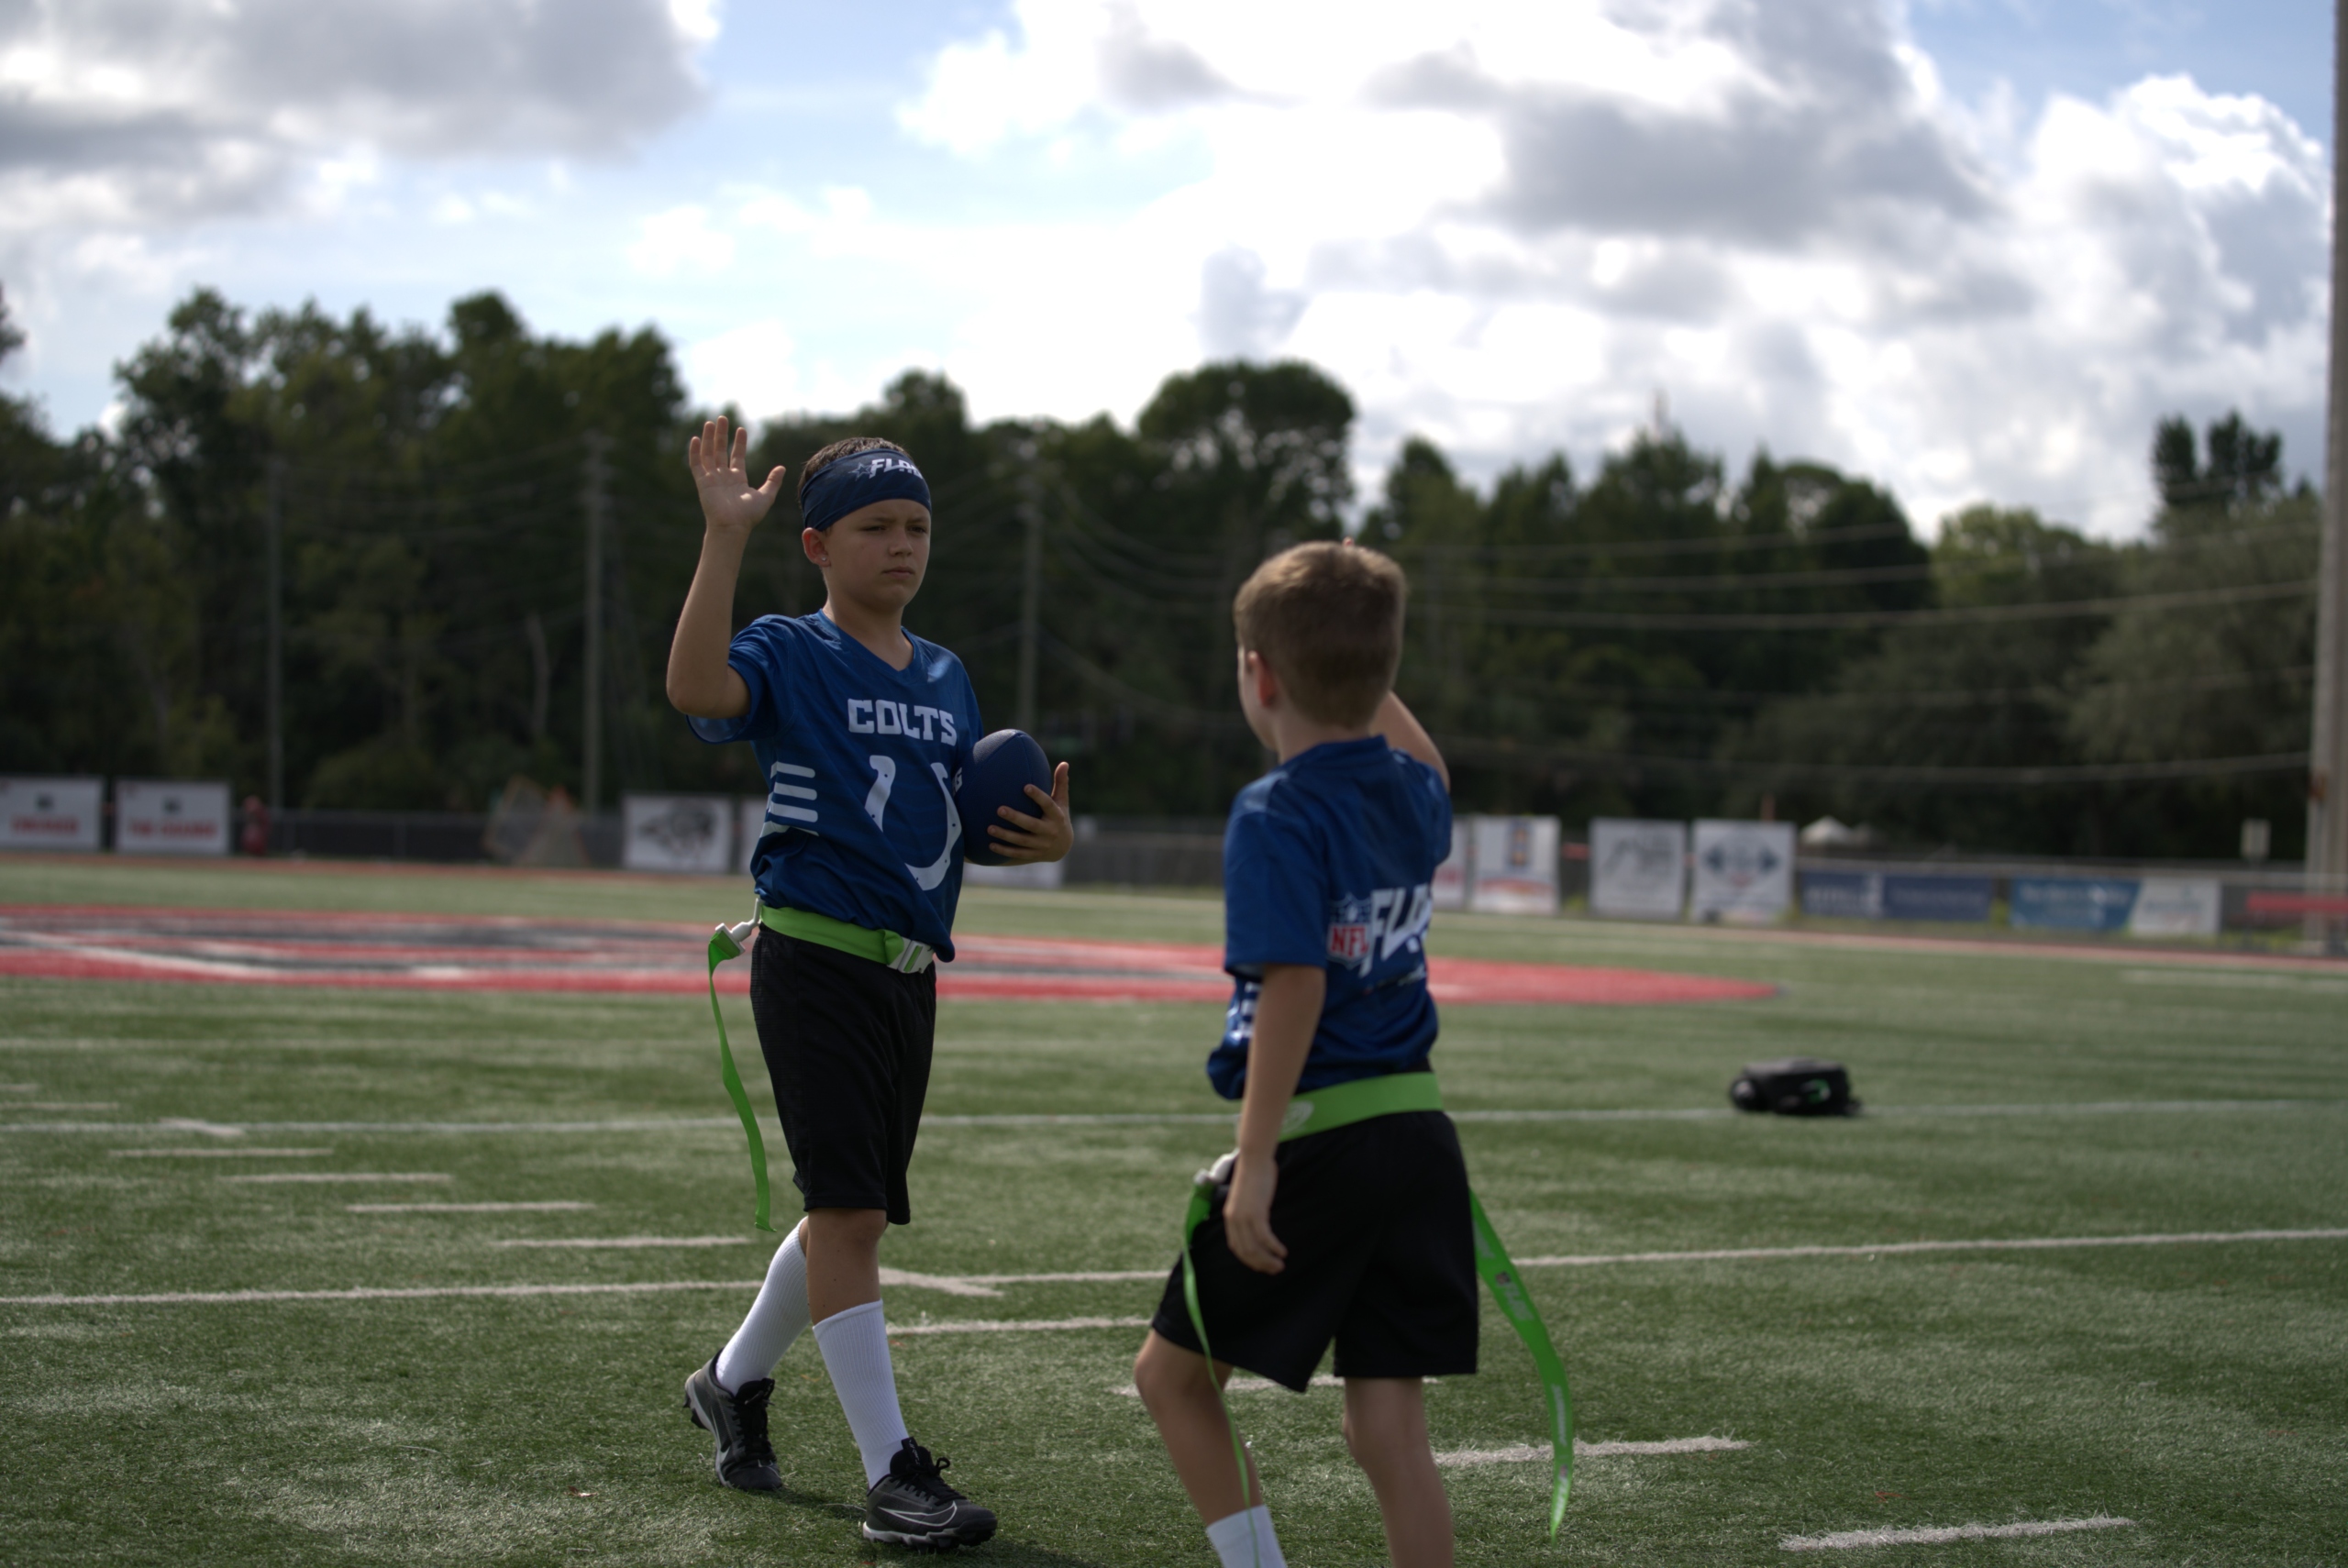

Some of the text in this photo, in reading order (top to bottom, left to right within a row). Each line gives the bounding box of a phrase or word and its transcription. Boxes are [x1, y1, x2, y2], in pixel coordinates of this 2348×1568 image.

[847, 698, 958, 746] COLTS
[1330, 926, 1369, 957] NFL
[1358, 883, 1433, 979] FLA
